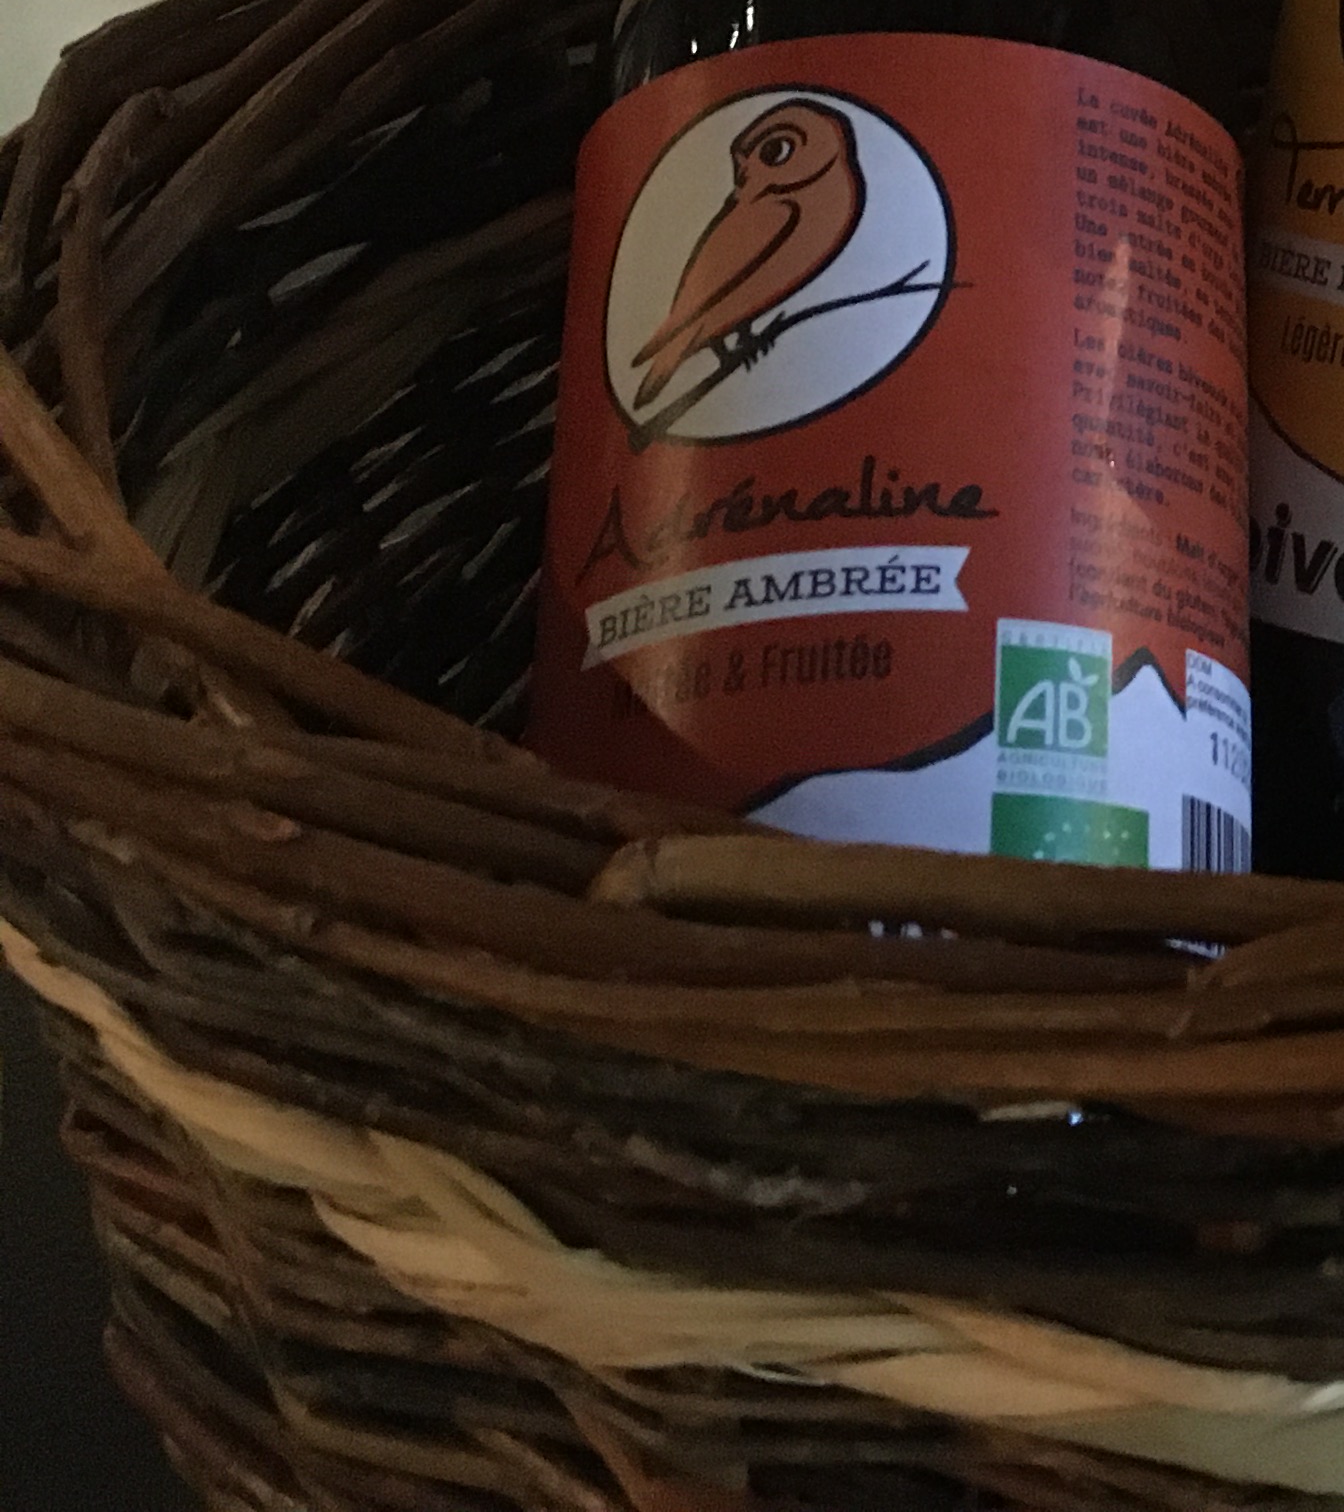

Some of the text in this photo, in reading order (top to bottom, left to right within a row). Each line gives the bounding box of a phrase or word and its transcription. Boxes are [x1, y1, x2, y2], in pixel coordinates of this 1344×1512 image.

[1076, 189, 1129, 218] trois
[598, 555, 942, 648] BIÈRE AMBRÉE
[1007, 678, 1093, 748] AB
